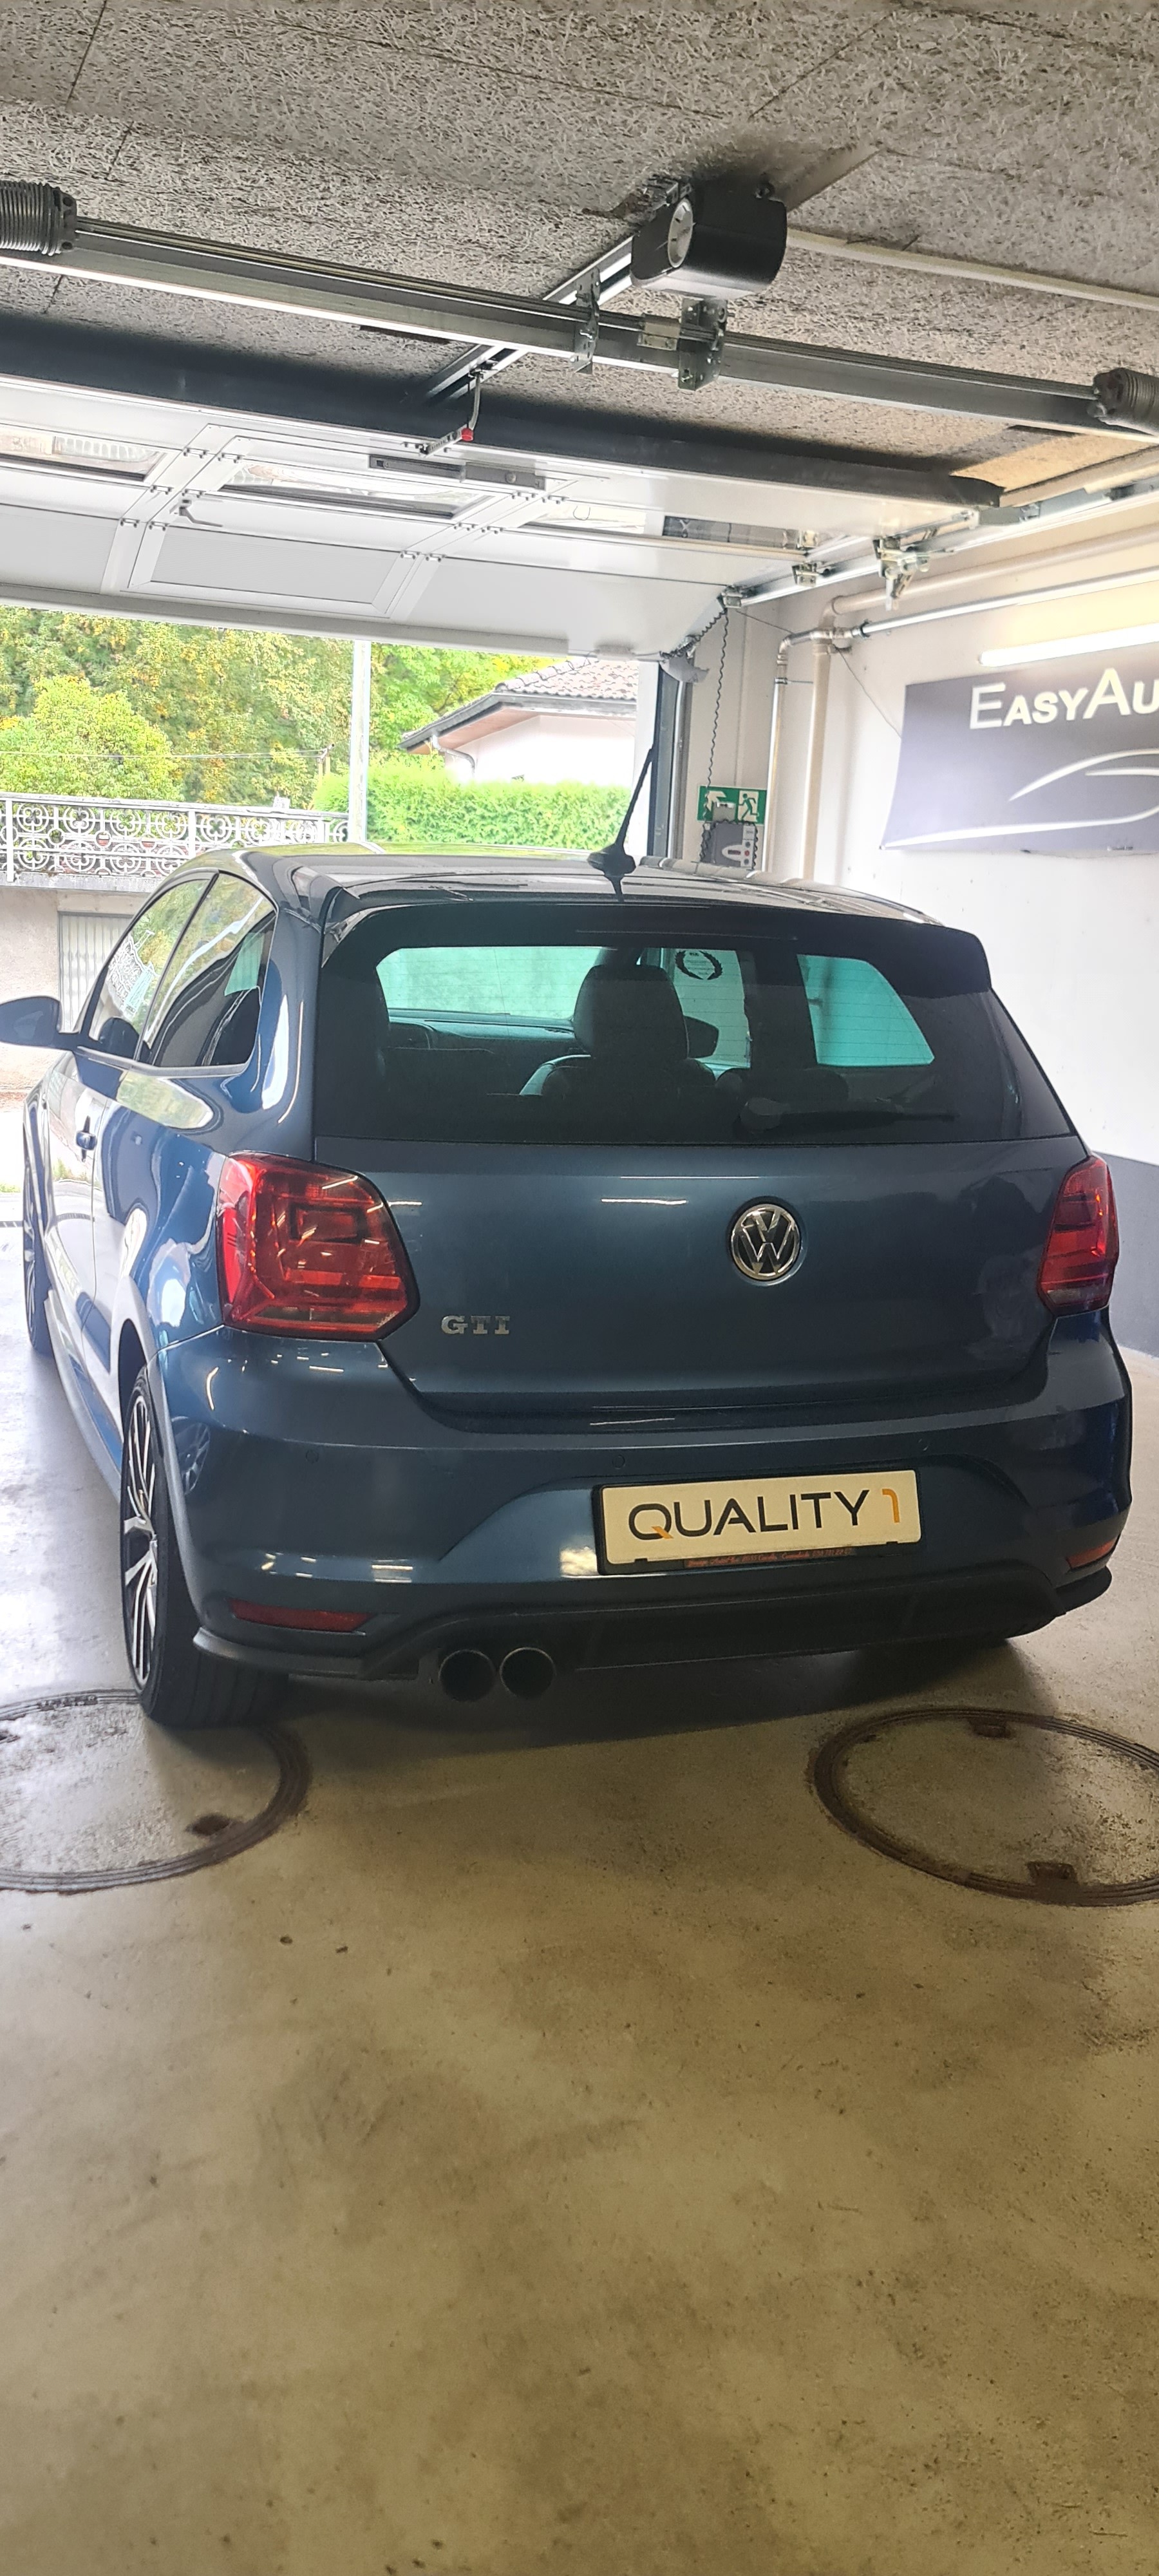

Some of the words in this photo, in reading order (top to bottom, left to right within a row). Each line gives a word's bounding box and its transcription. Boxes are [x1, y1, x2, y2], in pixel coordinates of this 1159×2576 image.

[441, 1315, 511, 1334] GTI
[628, 1490, 870, 1540] QUALITY
[882, 1488, 900, 1523] 1
